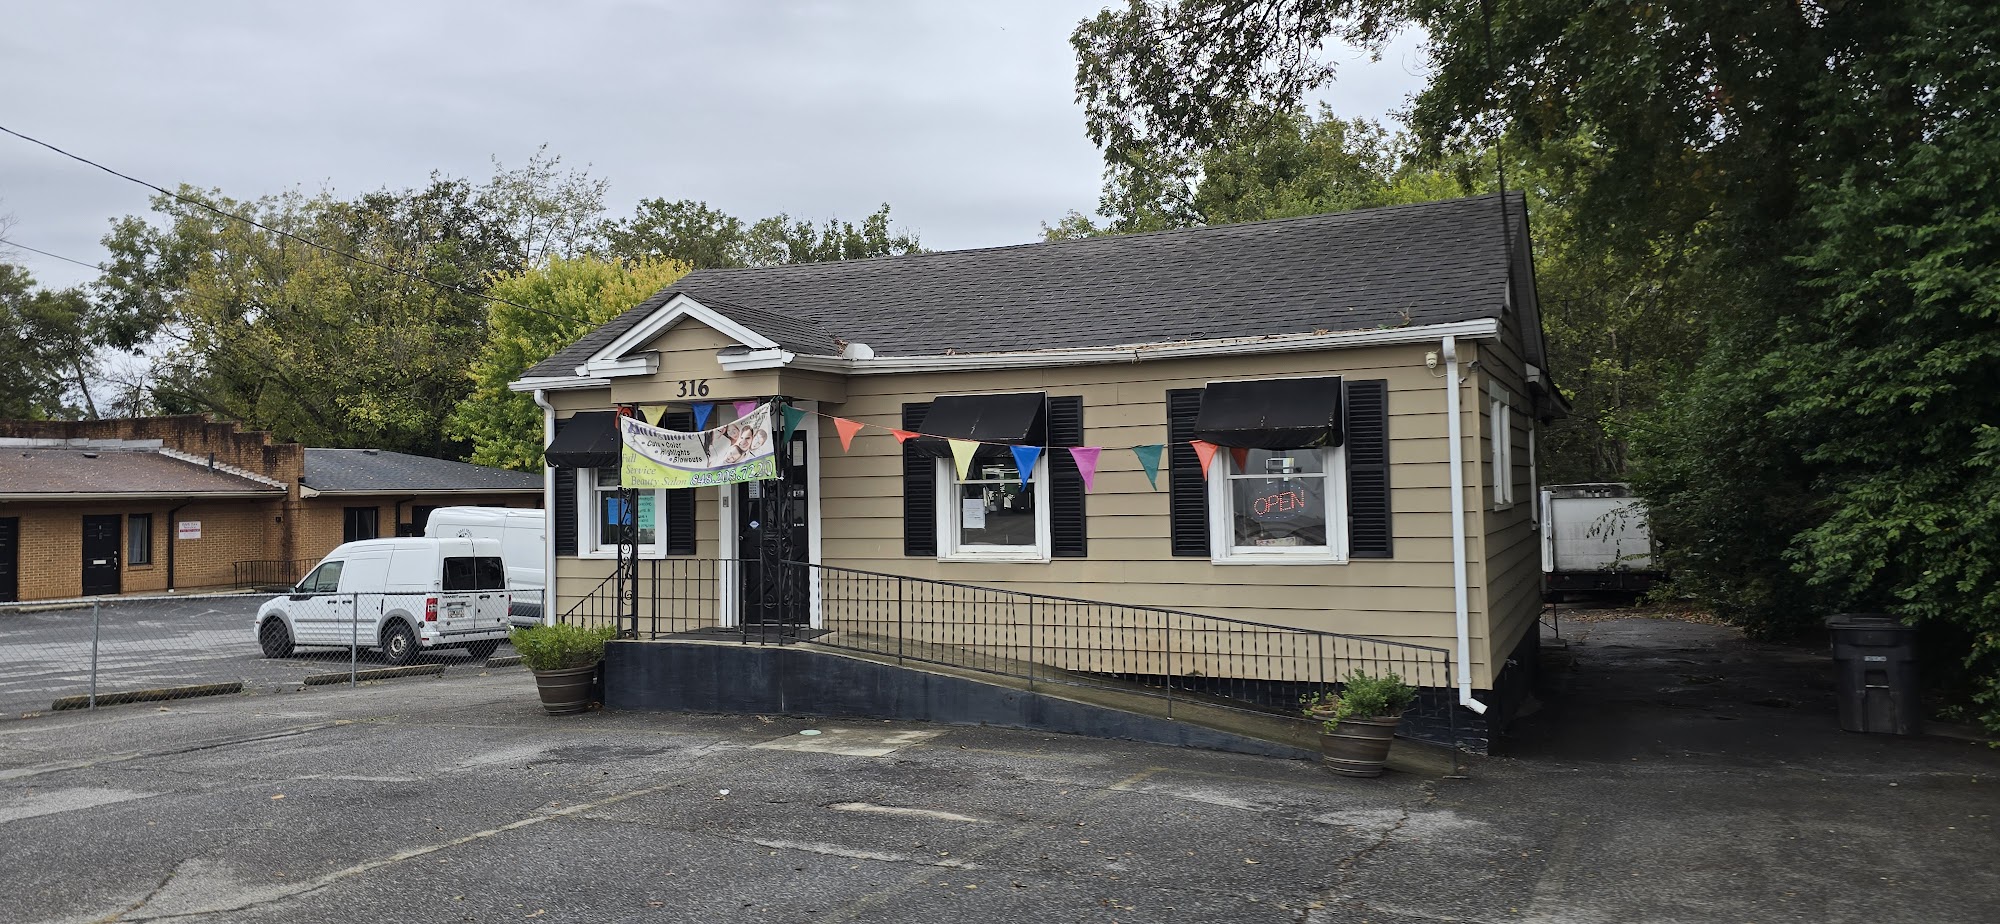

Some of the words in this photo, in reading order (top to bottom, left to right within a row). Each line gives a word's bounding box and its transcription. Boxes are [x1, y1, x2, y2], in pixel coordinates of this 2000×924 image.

[677, 379, 709, 397] 316
[665, 441, 682, 449] Color
[660, 448, 690, 456] Highlights
[622, 453, 637, 463] Full
[672, 456, 703, 464] Blowouts
[626, 465, 657, 475] Service
[631, 476, 659, 487] Beauty
[662, 476, 687, 486] Salon
[1253, 490, 1304, 515] OPEN
